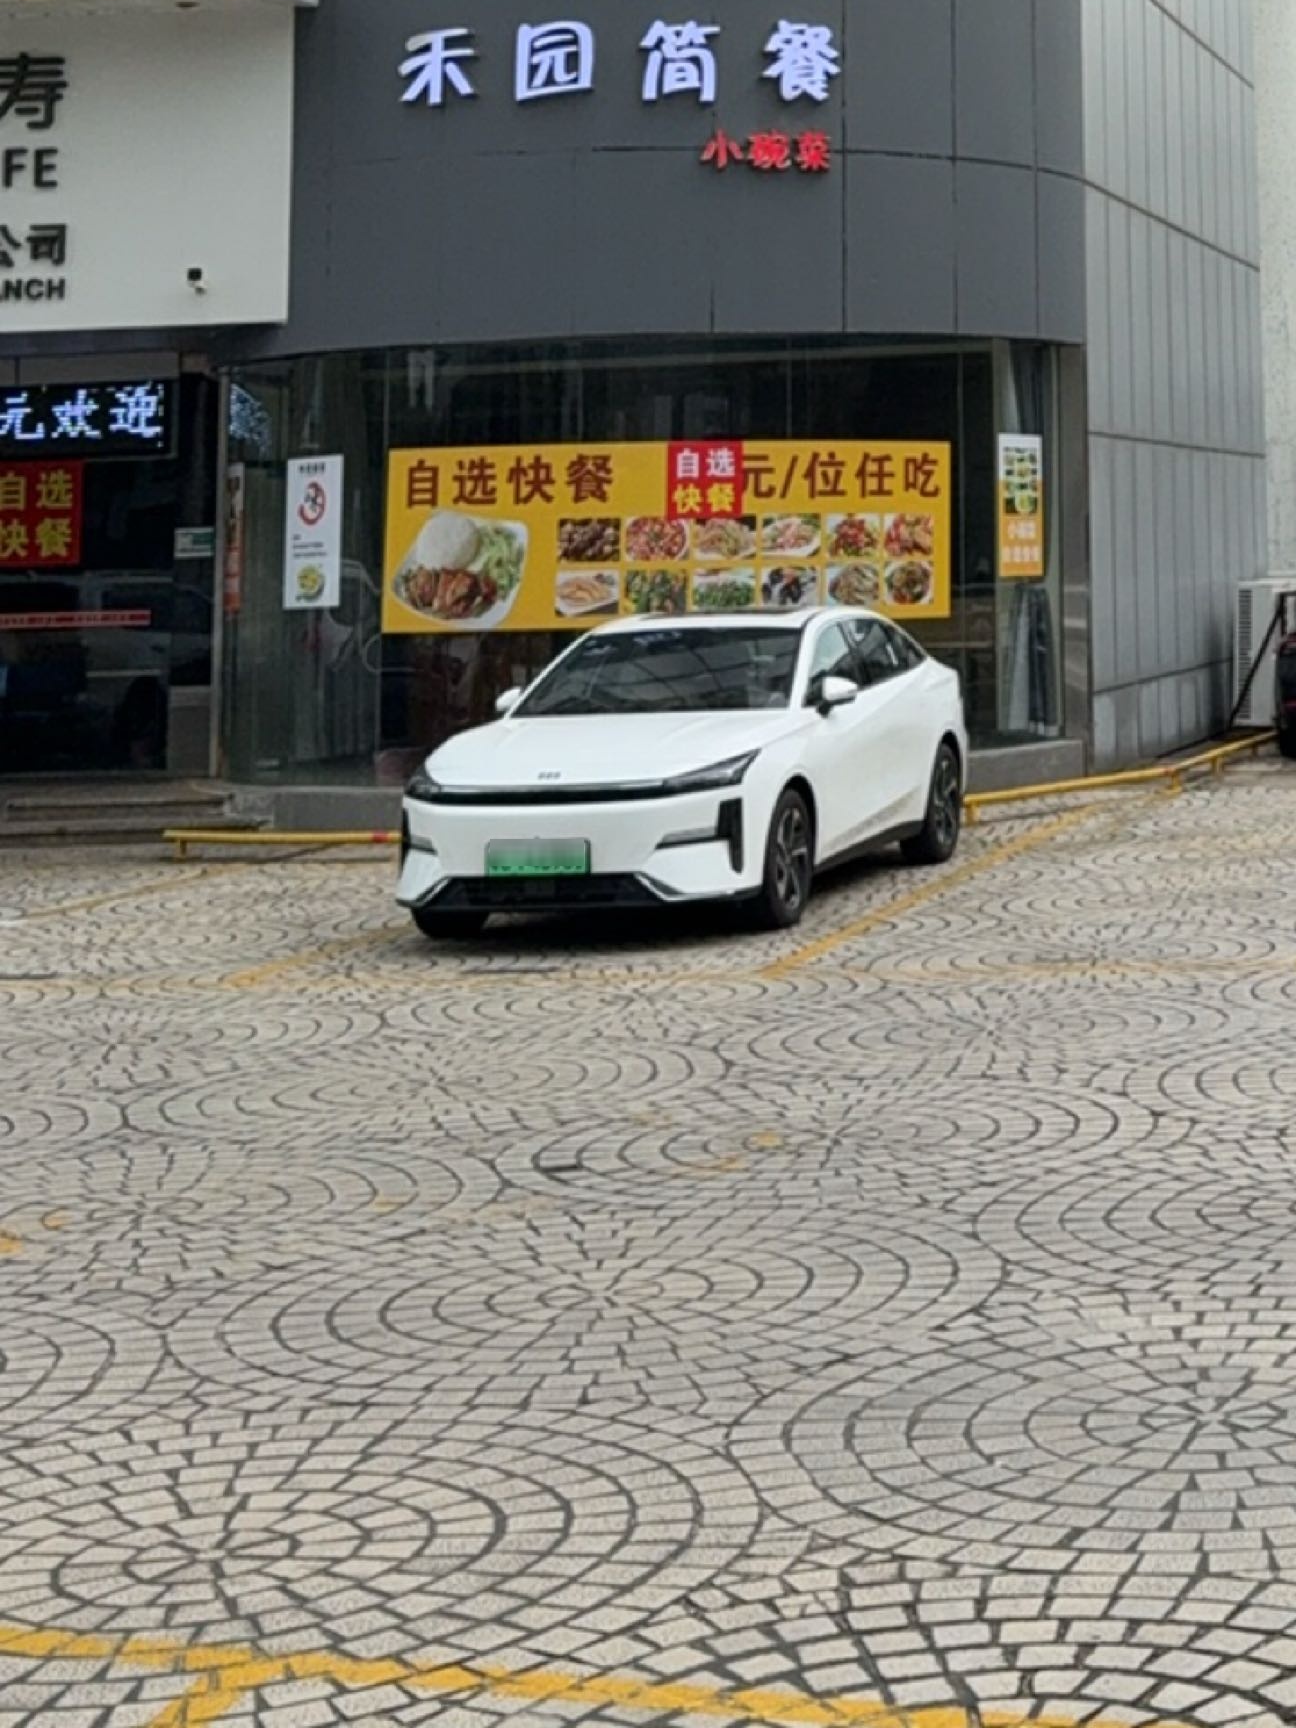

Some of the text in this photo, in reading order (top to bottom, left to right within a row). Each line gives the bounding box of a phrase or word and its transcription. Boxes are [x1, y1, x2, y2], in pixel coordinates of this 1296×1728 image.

[398, 18, 841, 106] 禾园简餐
[700, 129, 831, 172] 小碗菜
[0, 277, 66, 301] NCH
[406, 453, 614, 509] 自选快餐
[676, 447, 736, 478] 自选
[0, 469, 73, 511] 自选
[673, 482, 736, 513] 快餐
